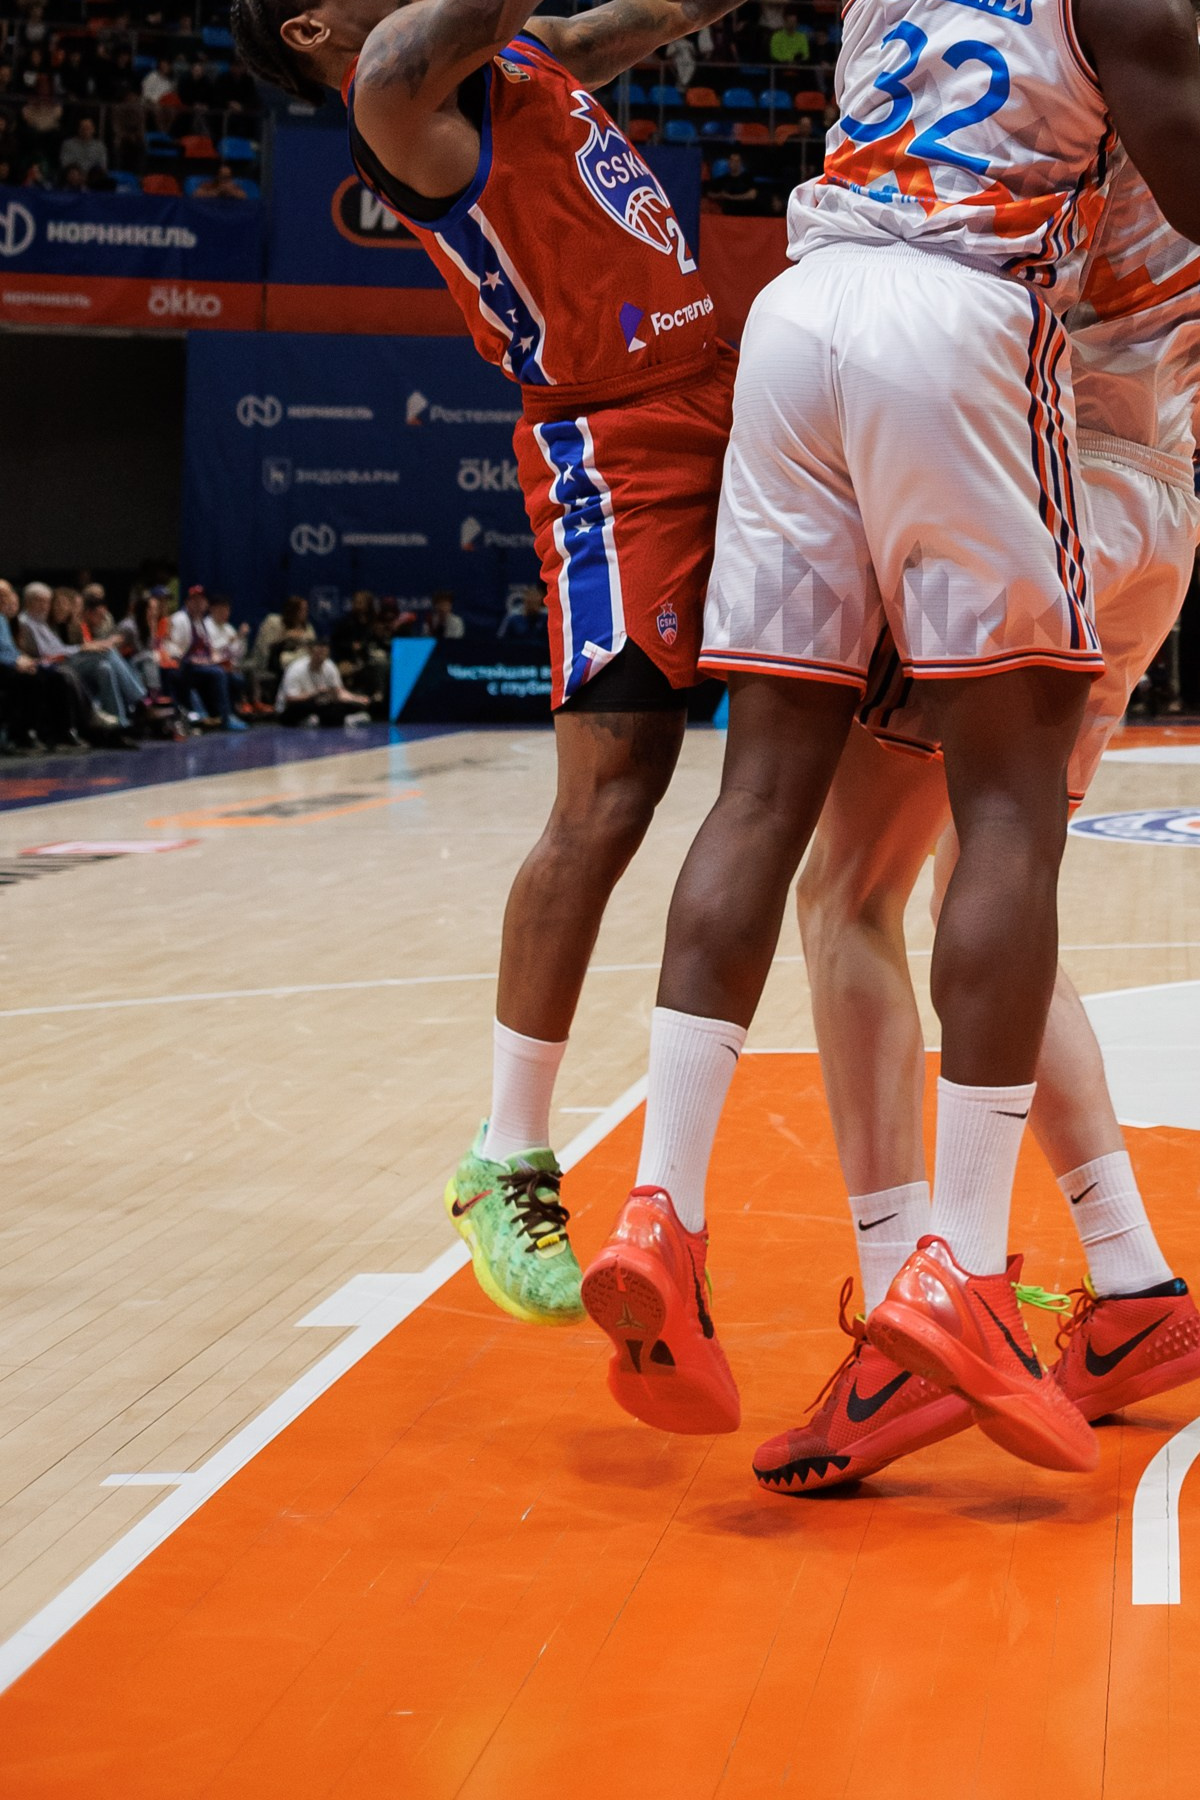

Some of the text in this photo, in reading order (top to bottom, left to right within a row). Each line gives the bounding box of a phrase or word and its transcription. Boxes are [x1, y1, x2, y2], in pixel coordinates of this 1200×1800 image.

[840, 20, 1010, 175] 32
[47, 221, 197, 249] НОРНИКЕЛЬ
[666, 216, 697, 275] 2
[660, 617, 676, 628] CSKA
